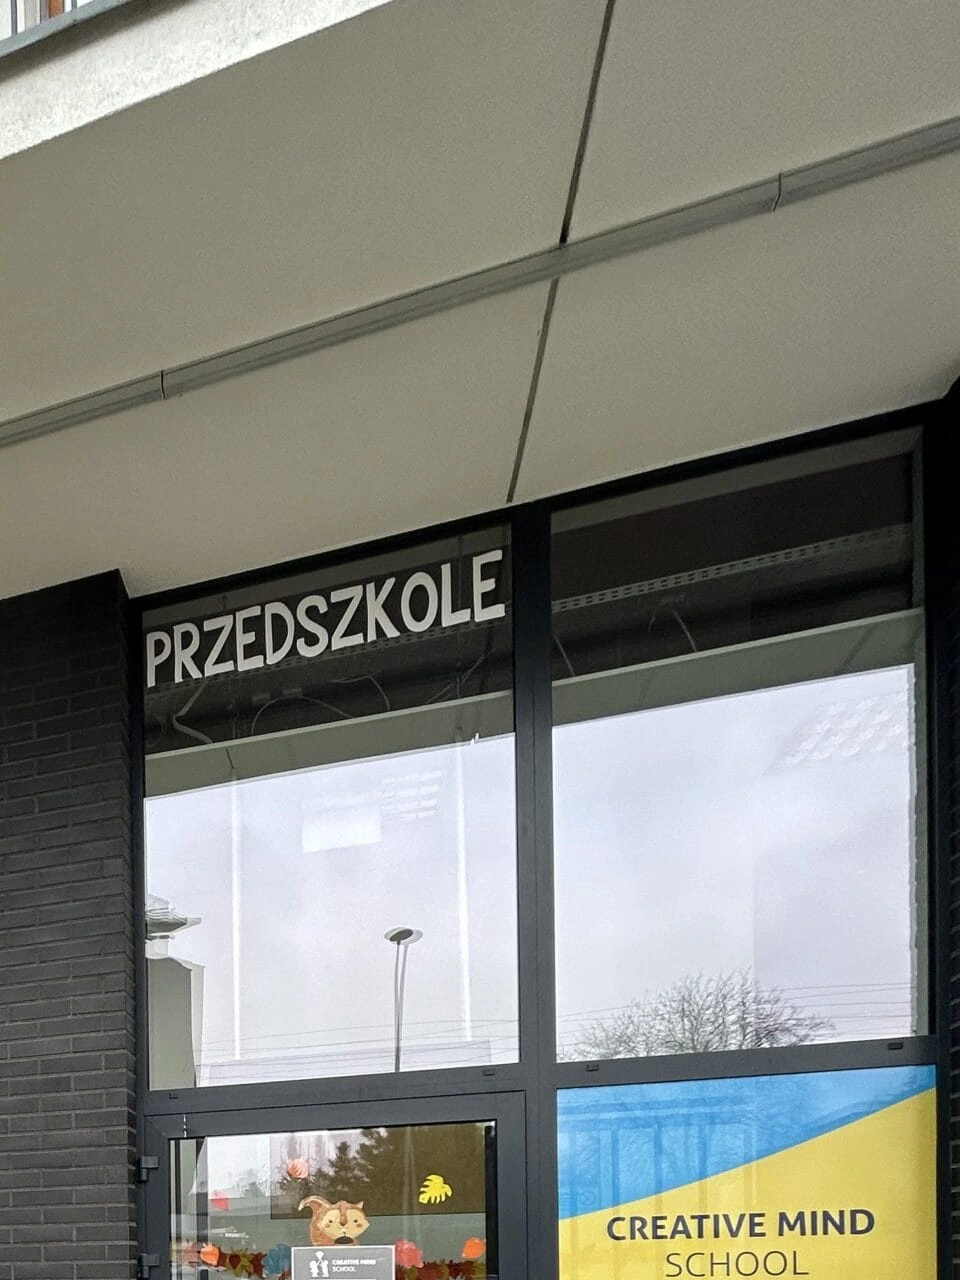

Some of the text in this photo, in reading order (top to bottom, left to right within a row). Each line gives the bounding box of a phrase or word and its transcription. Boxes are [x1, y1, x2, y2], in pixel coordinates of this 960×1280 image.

[146, 549, 506, 688] PRZEDSZKOLE
[607, 1208, 876, 1241] CREATIVE MIND
[665, 1250, 810, 1278] SCHOOL
